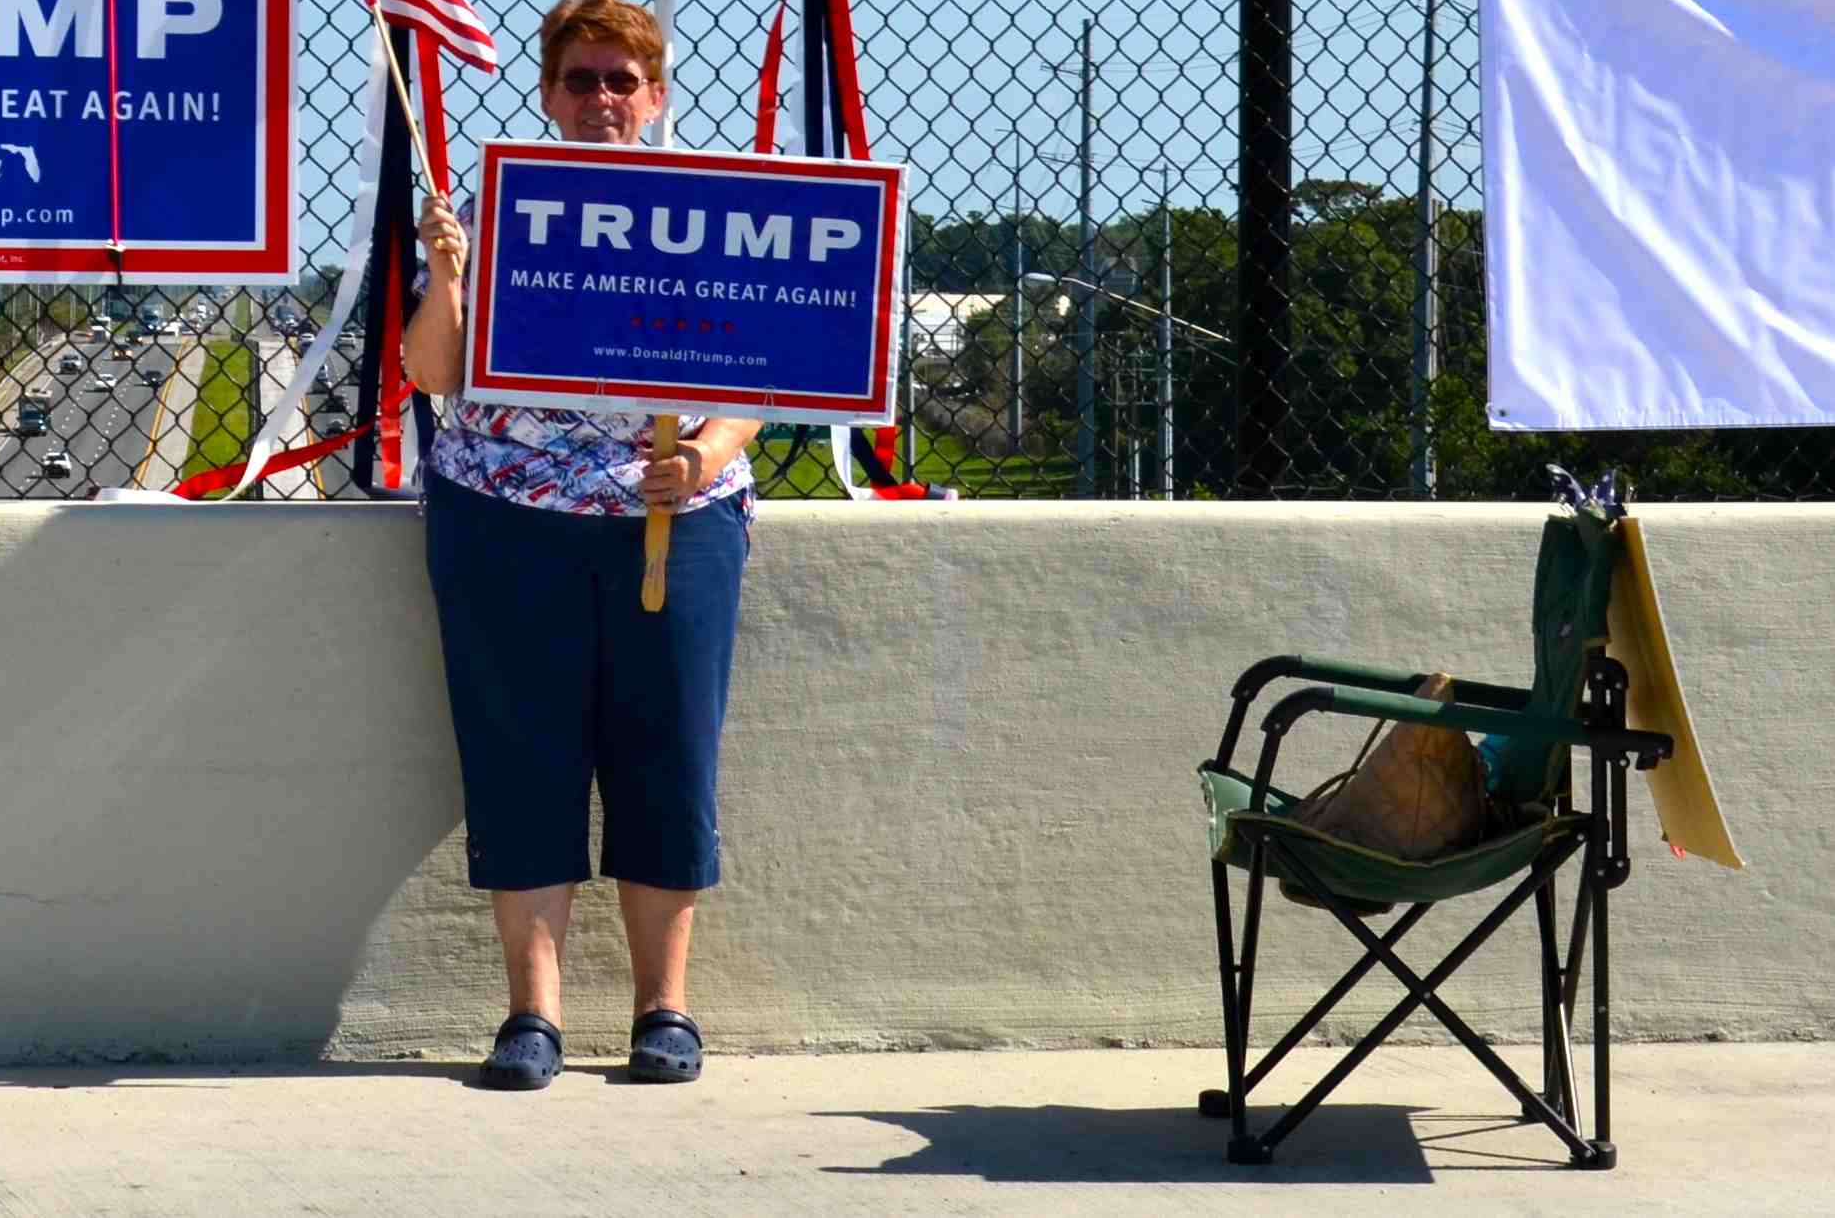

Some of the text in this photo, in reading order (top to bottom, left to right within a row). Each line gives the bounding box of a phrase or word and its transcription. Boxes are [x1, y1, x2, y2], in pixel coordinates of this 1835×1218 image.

[81, 90, 220, 122] AGAIN!
[515, 199, 862, 262] TRUMP
[510, 269, 858, 308] MAKE AMERICA GREAT AGAIN!
